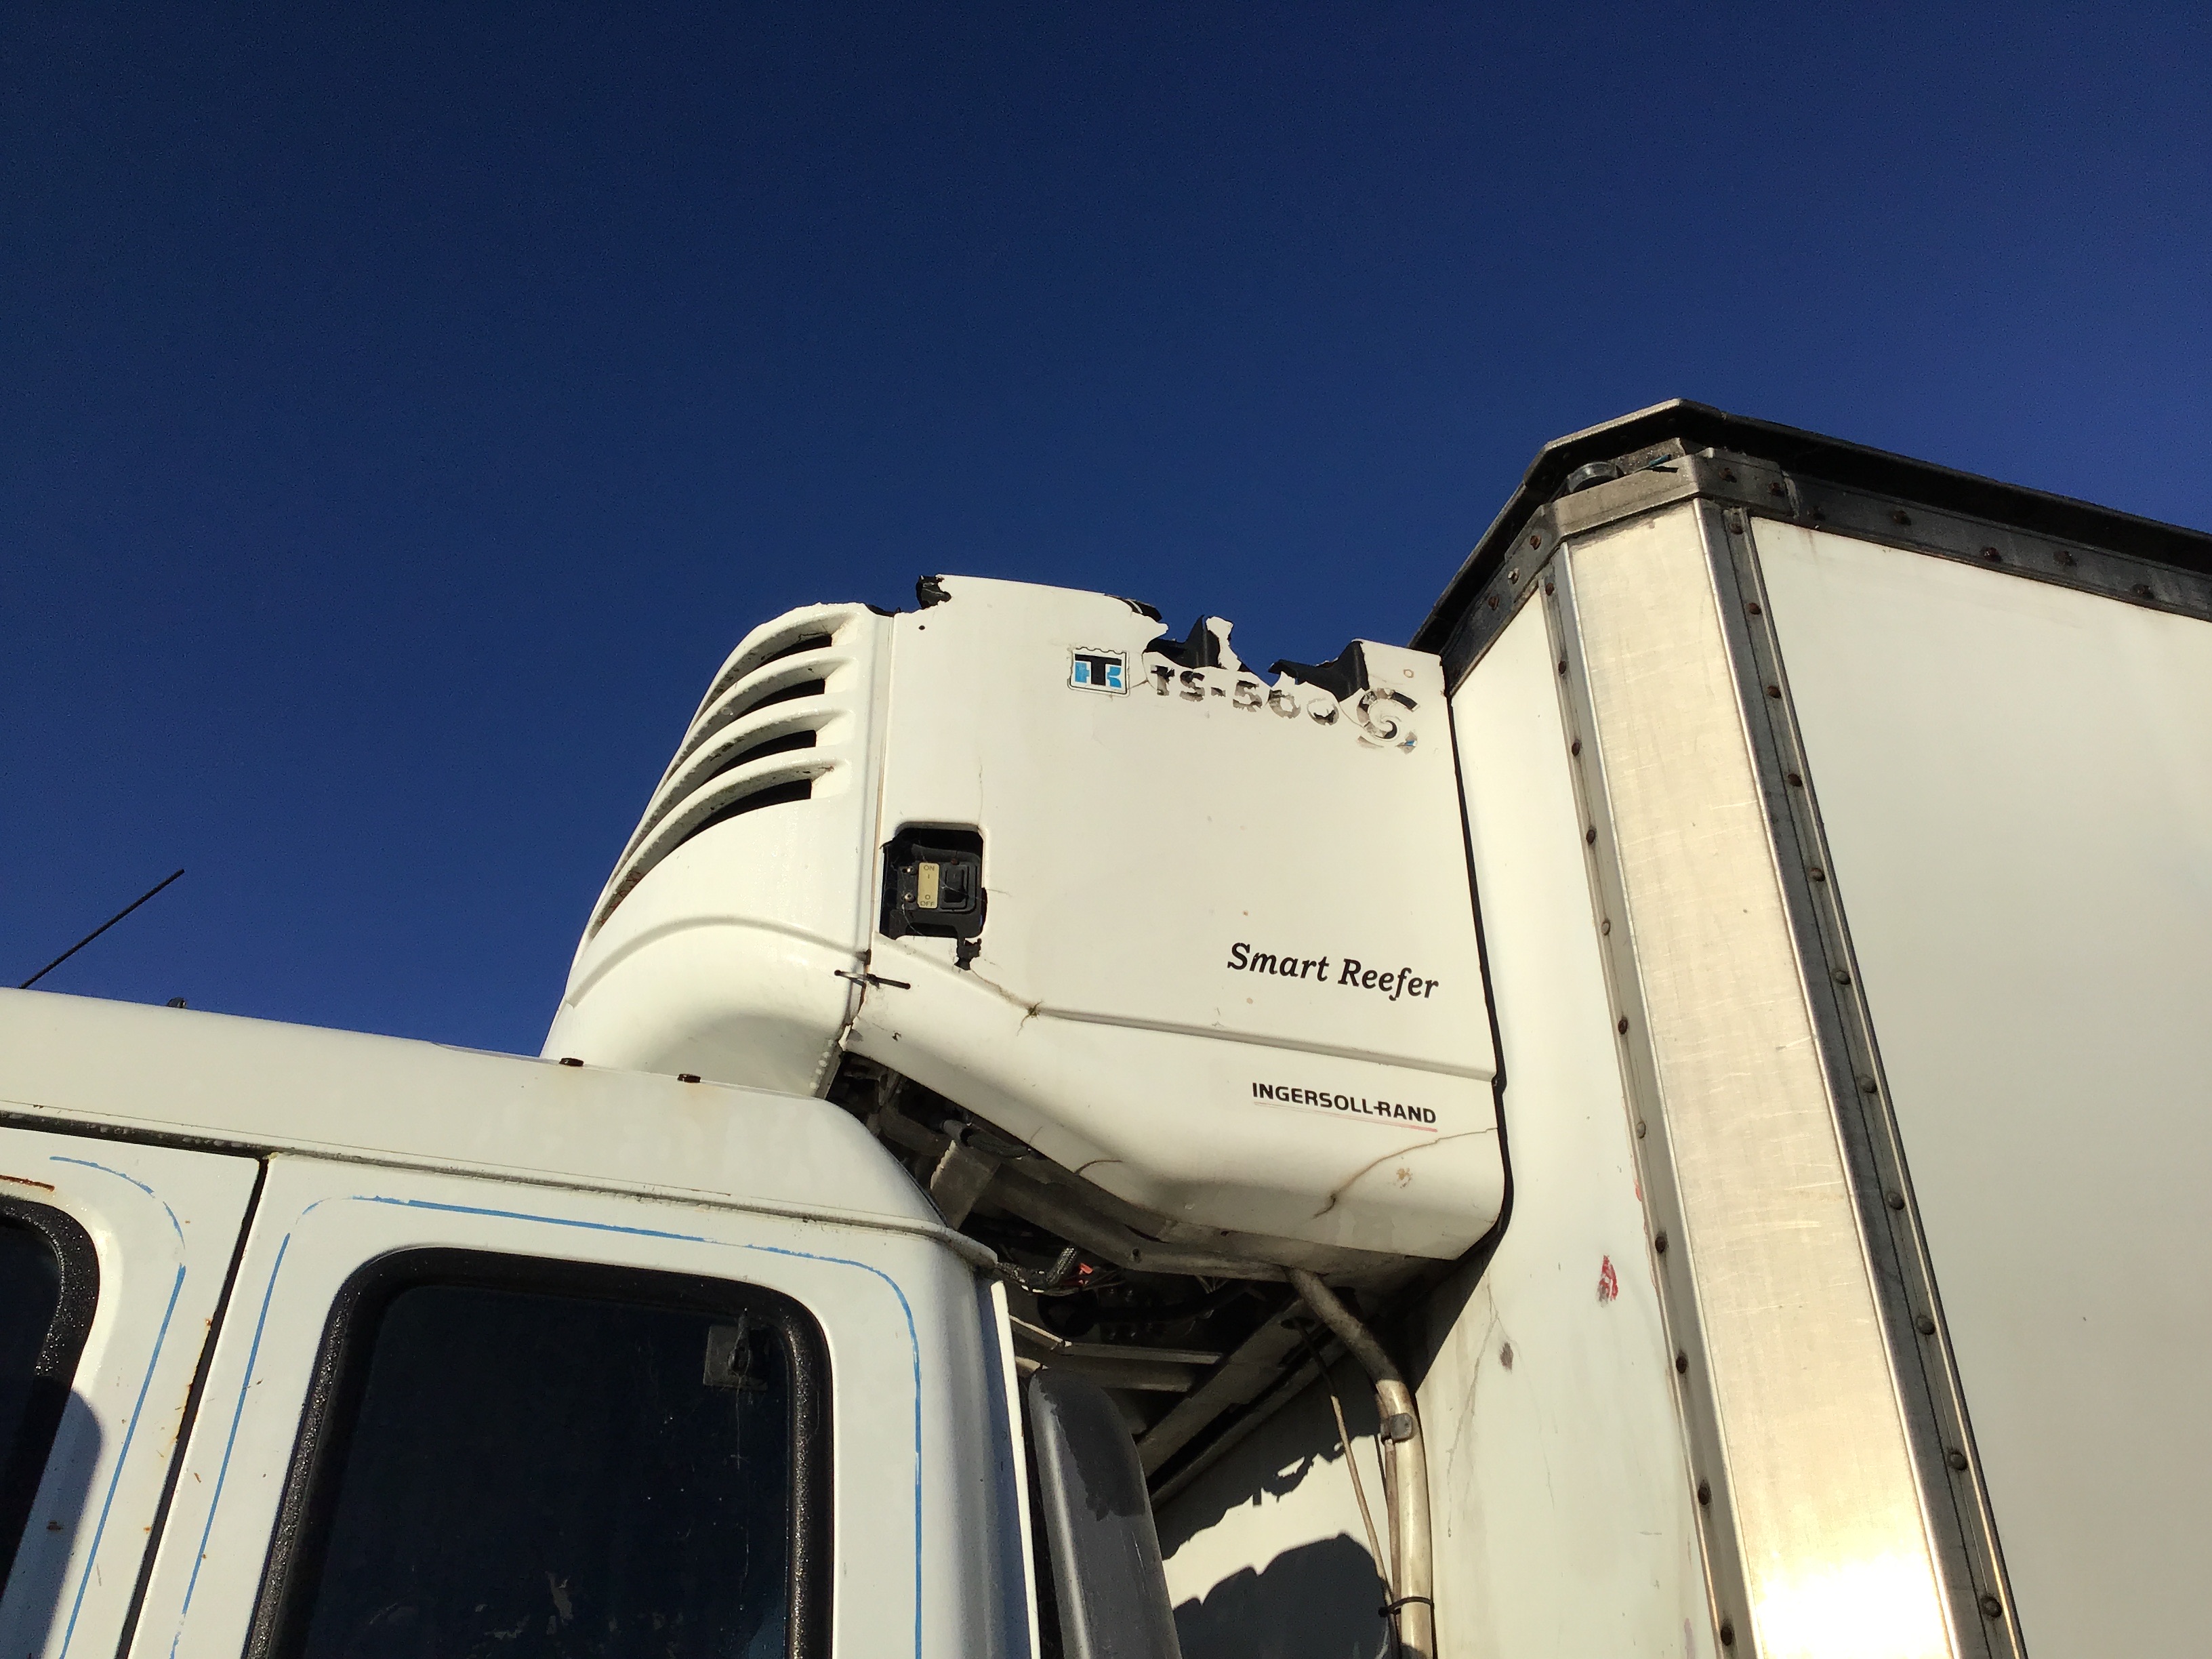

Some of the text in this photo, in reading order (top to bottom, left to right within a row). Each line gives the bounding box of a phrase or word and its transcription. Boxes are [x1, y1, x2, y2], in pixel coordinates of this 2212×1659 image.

[1227, 942, 1439, 1002] Smart Reefer
[1252, 1082, 1437, 1124] INGERSOLL-RAND
